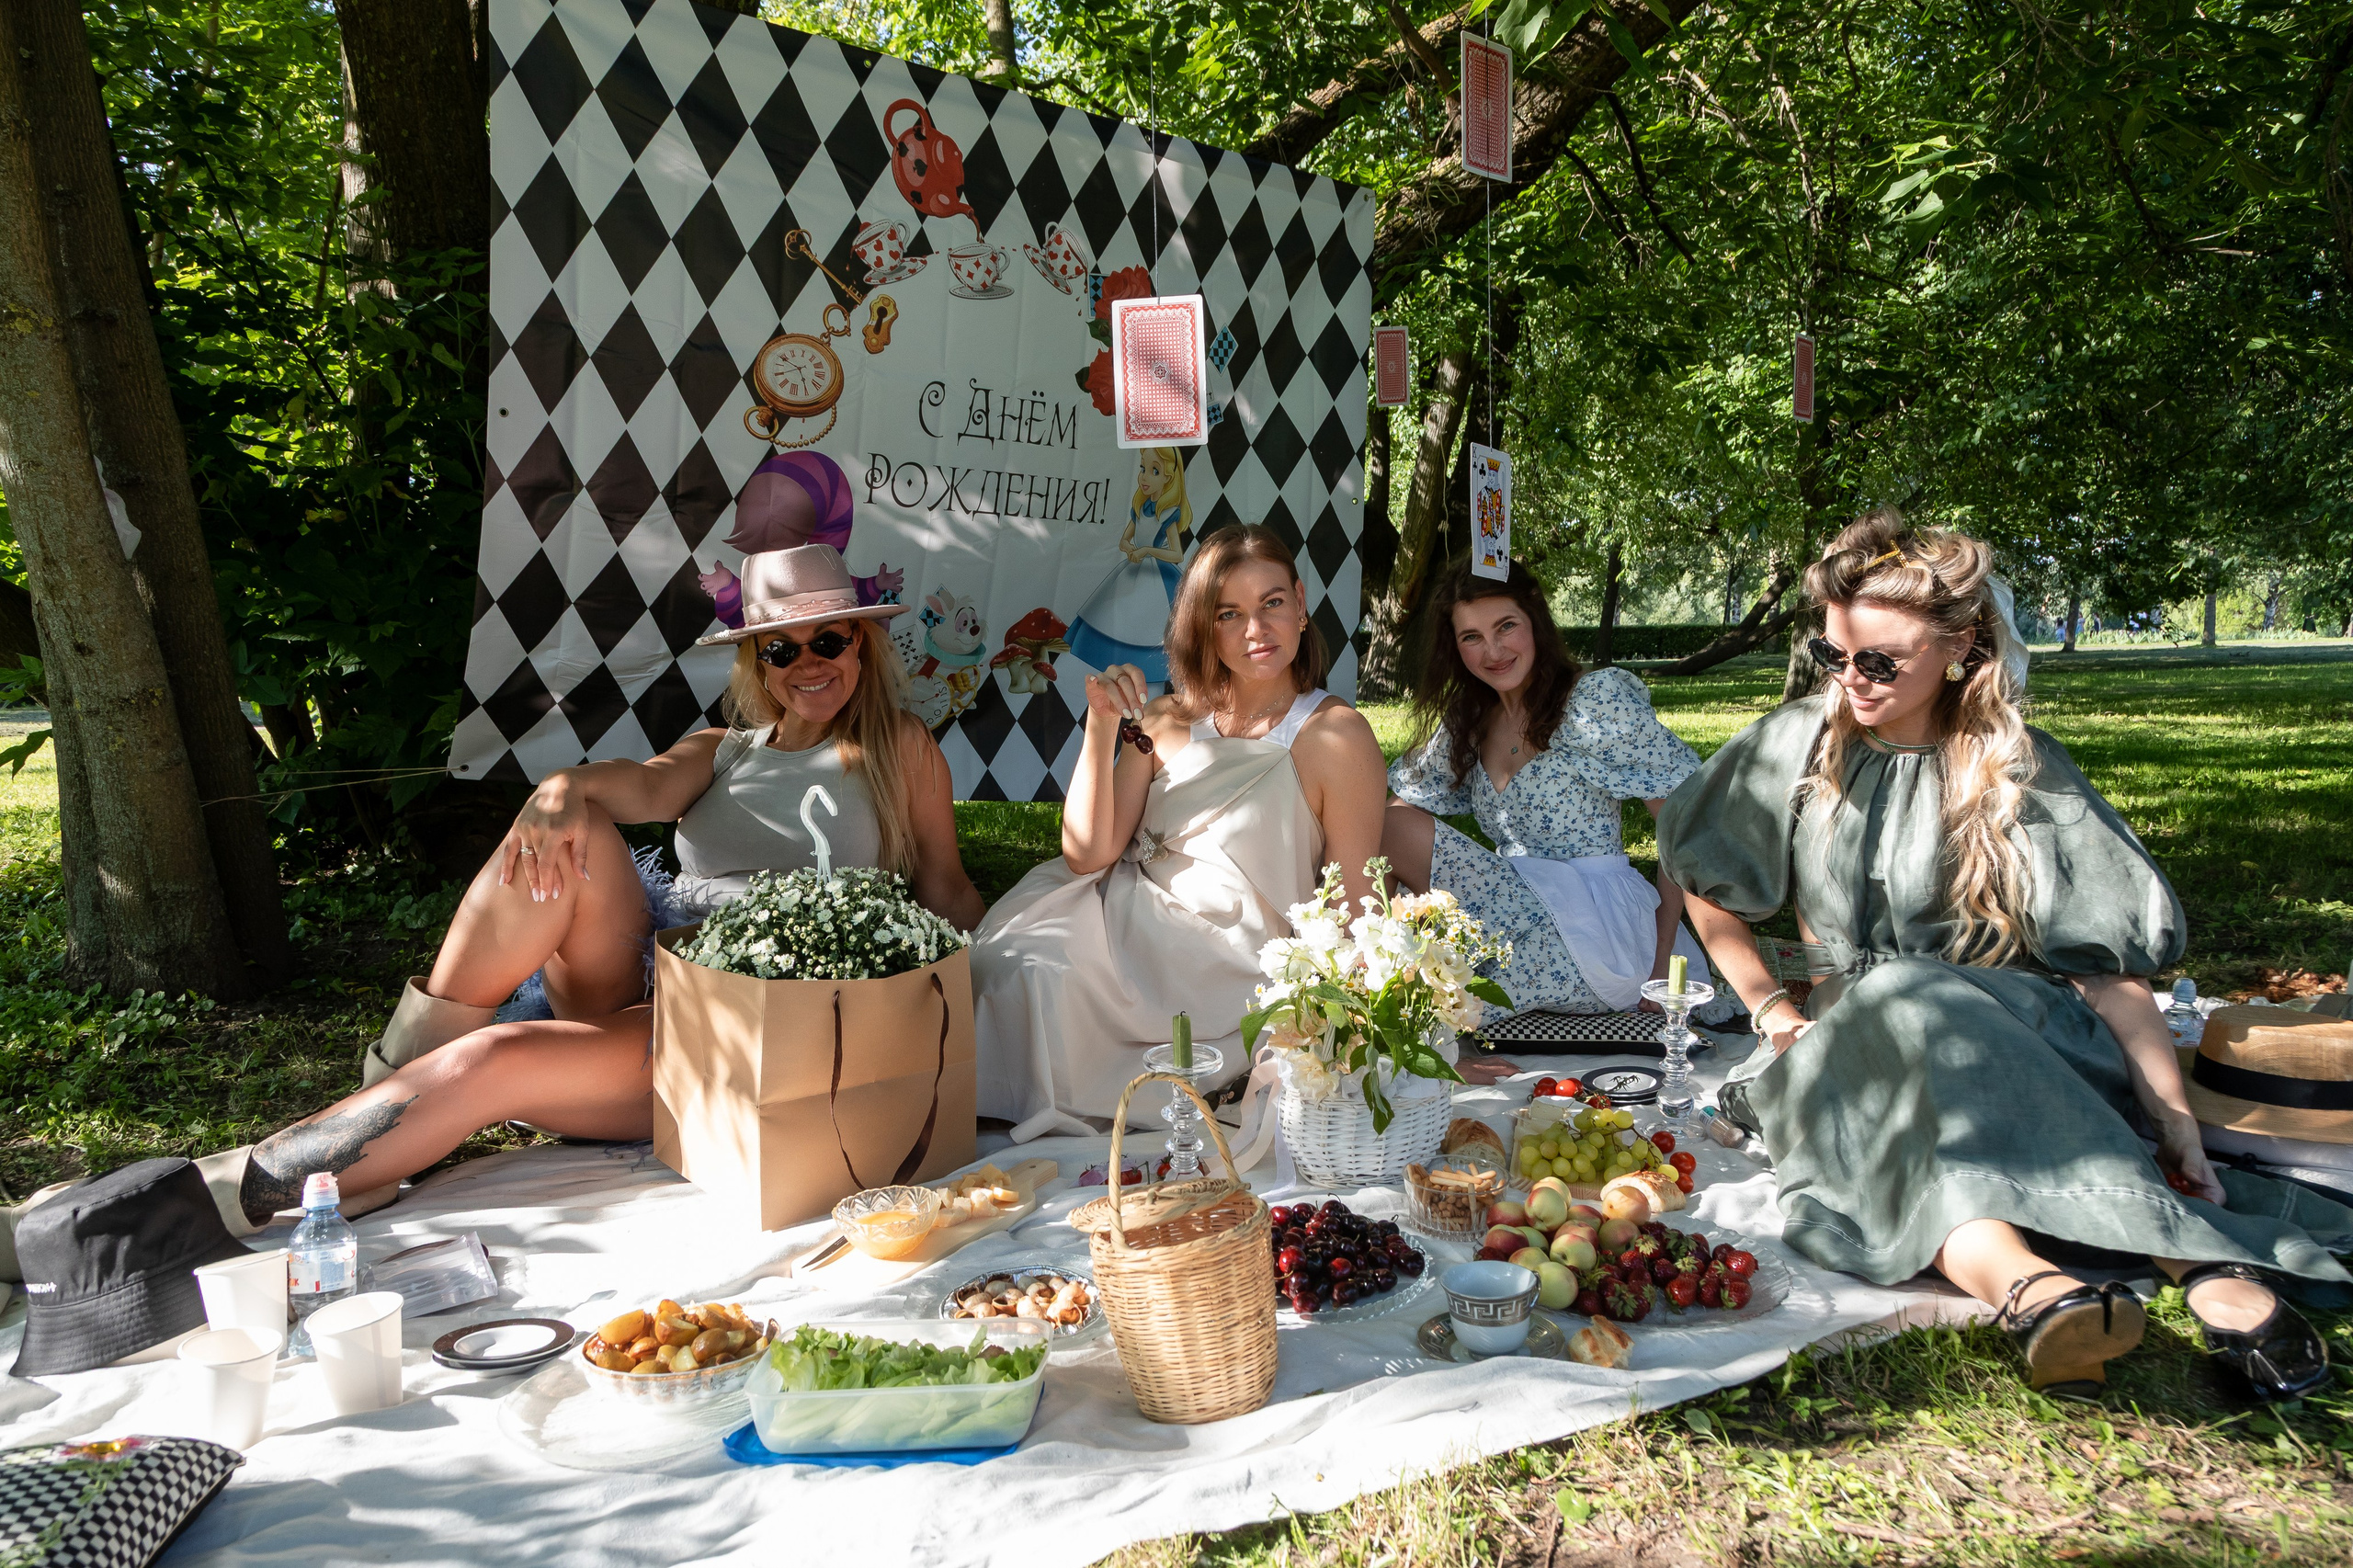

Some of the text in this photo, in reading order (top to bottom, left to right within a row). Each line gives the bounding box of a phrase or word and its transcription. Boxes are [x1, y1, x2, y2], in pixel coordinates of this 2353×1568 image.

[918, 378, 1079, 449] С ДНЁМ
[862, 452, 1111, 525] РОЖДЕНИЯ!
